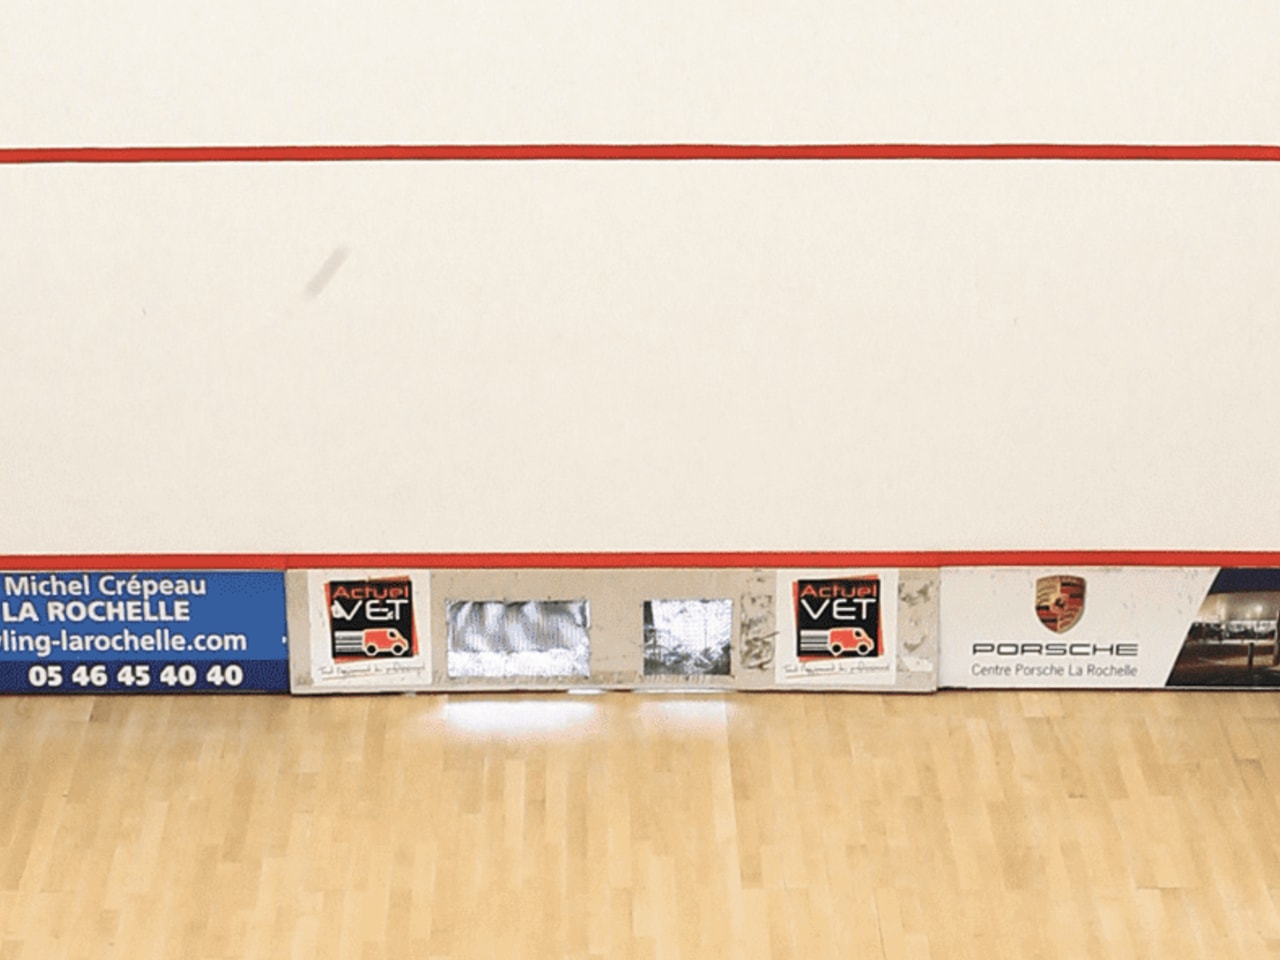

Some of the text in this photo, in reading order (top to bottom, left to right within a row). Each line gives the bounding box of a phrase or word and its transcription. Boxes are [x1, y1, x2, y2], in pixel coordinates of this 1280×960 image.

[4, 574, 91, 597] Michel
[98, 574, 207, 600] Crépeau
[332, 585, 410, 599] Actuel
[800, 583, 878, 598] Actuel
[2, 601, 40, 622] LA
[47, 600, 191, 622] ROCHELLE
[332, 599, 410, 621] VET
[800, 598, 877, 620] VET
[972, 643, 1139, 656] PORSCHE
[28, 664, 244, 687] 05 46 45 40 40
[971, 663, 1138, 677] Centre Porsche La Rochelle
